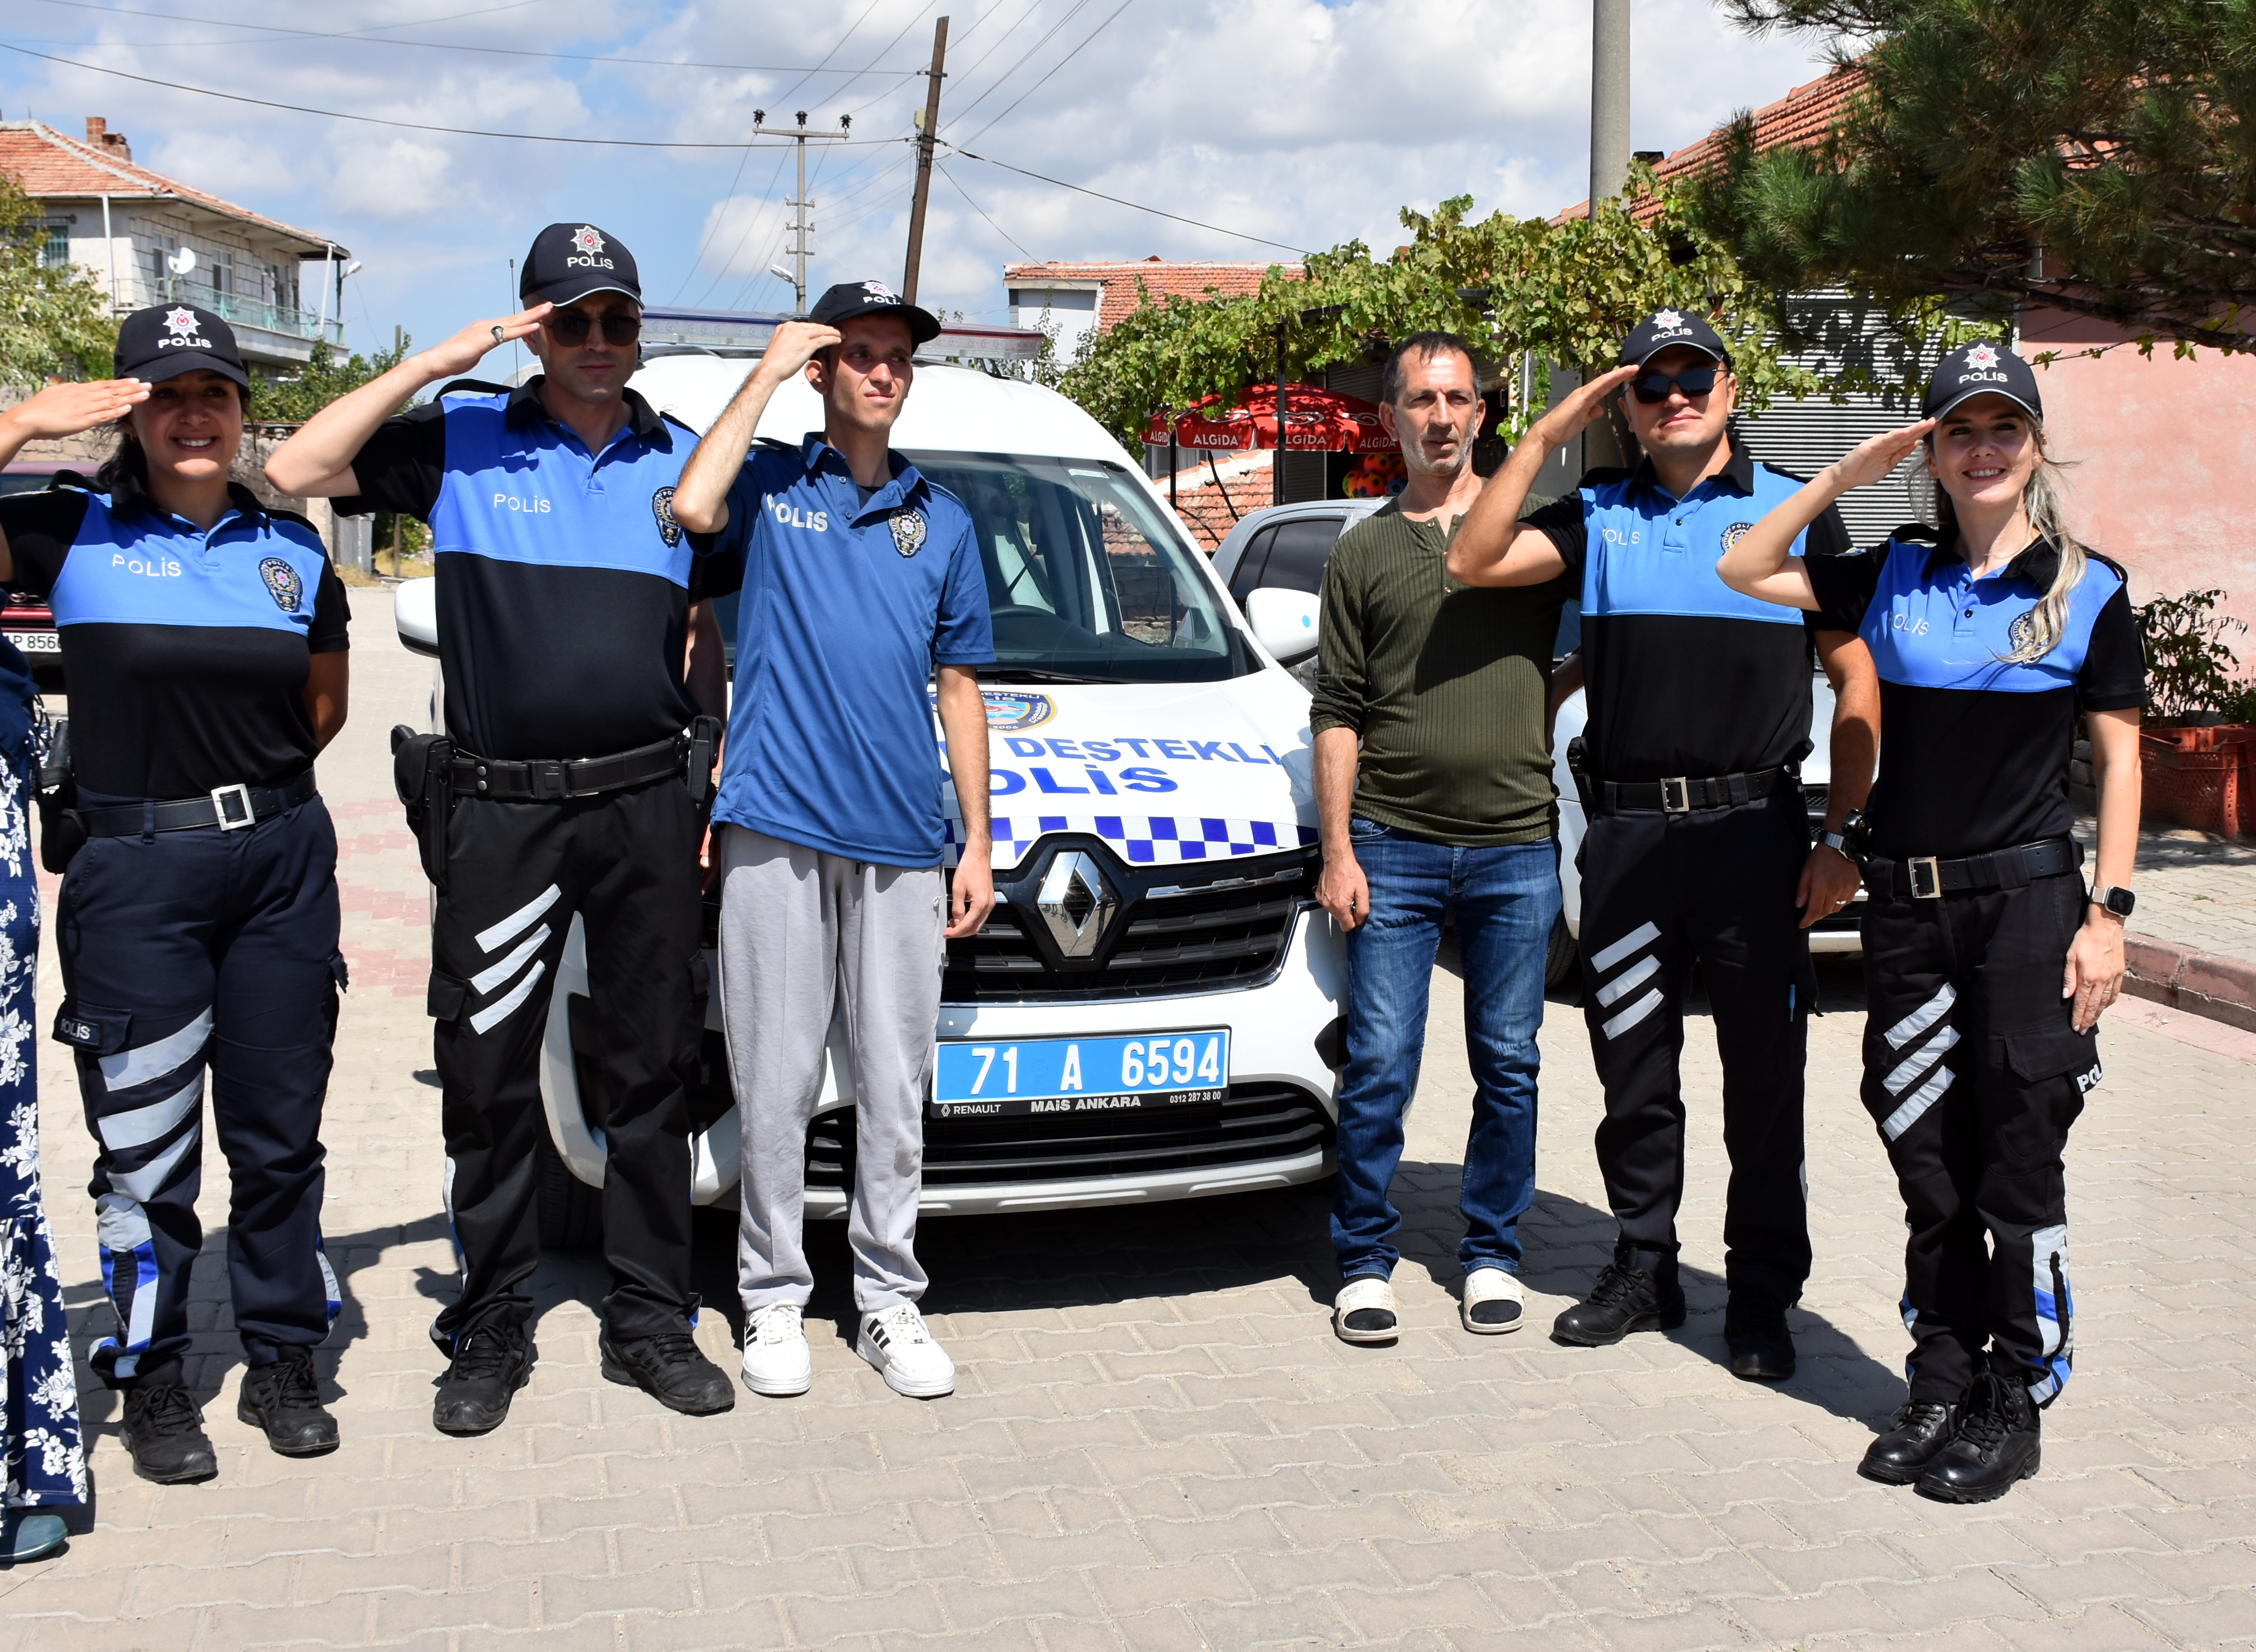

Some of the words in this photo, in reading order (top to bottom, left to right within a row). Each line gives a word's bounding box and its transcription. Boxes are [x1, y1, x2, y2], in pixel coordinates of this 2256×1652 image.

[863, 296, 901, 305] POLİ
[494, 493, 551, 514] POLİS
[112, 554, 182, 577] POLİS
[943, 764, 1178, 796] OLİS
[970, 1046, 1018, 1095] 71
[1060, 1044, 1083, 1091] A
[1121, 1037, 1219, 1087] 6594
[1075, 1096, 1141, 1110] ANKARA
[1170, 1095, 1187, 1103] 0312
[1188, 1092, 1201, 1102] 287
[1202, 1091, 1211, 1101] 38
[1212, 1090, 1221, 1100] 00
[953, 1104, 1001, 1115] RENAULT
